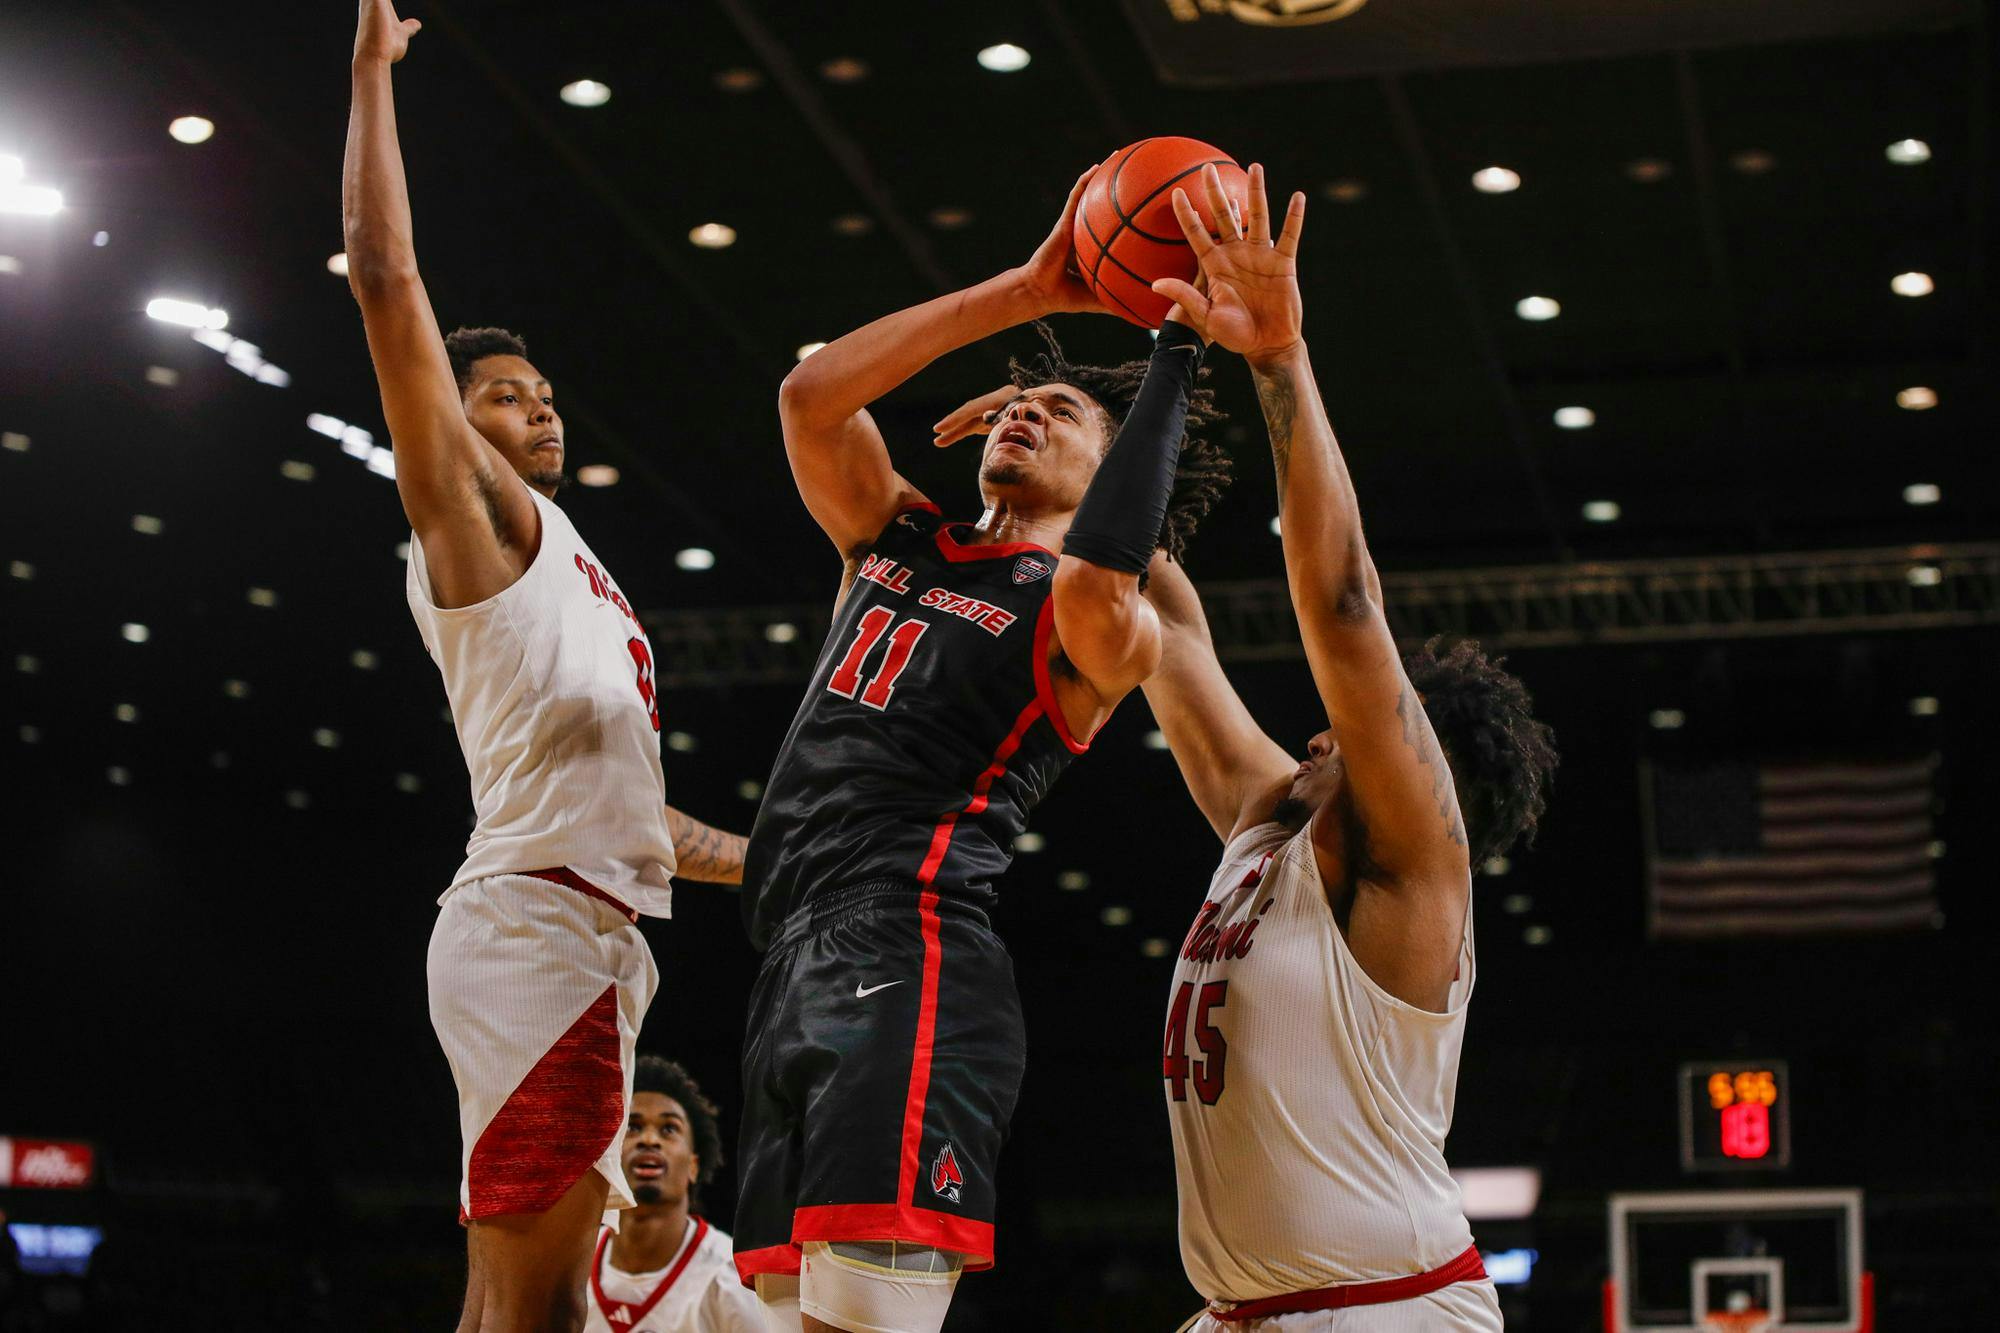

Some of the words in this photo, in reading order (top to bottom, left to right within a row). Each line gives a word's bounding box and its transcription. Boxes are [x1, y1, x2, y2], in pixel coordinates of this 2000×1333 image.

[860, 552, 915, 596] BALL
[918, 587, 1018, 638] STATE
[826, 604, 931, 713] 11
[1163, 979, 1229, 1107] 45
